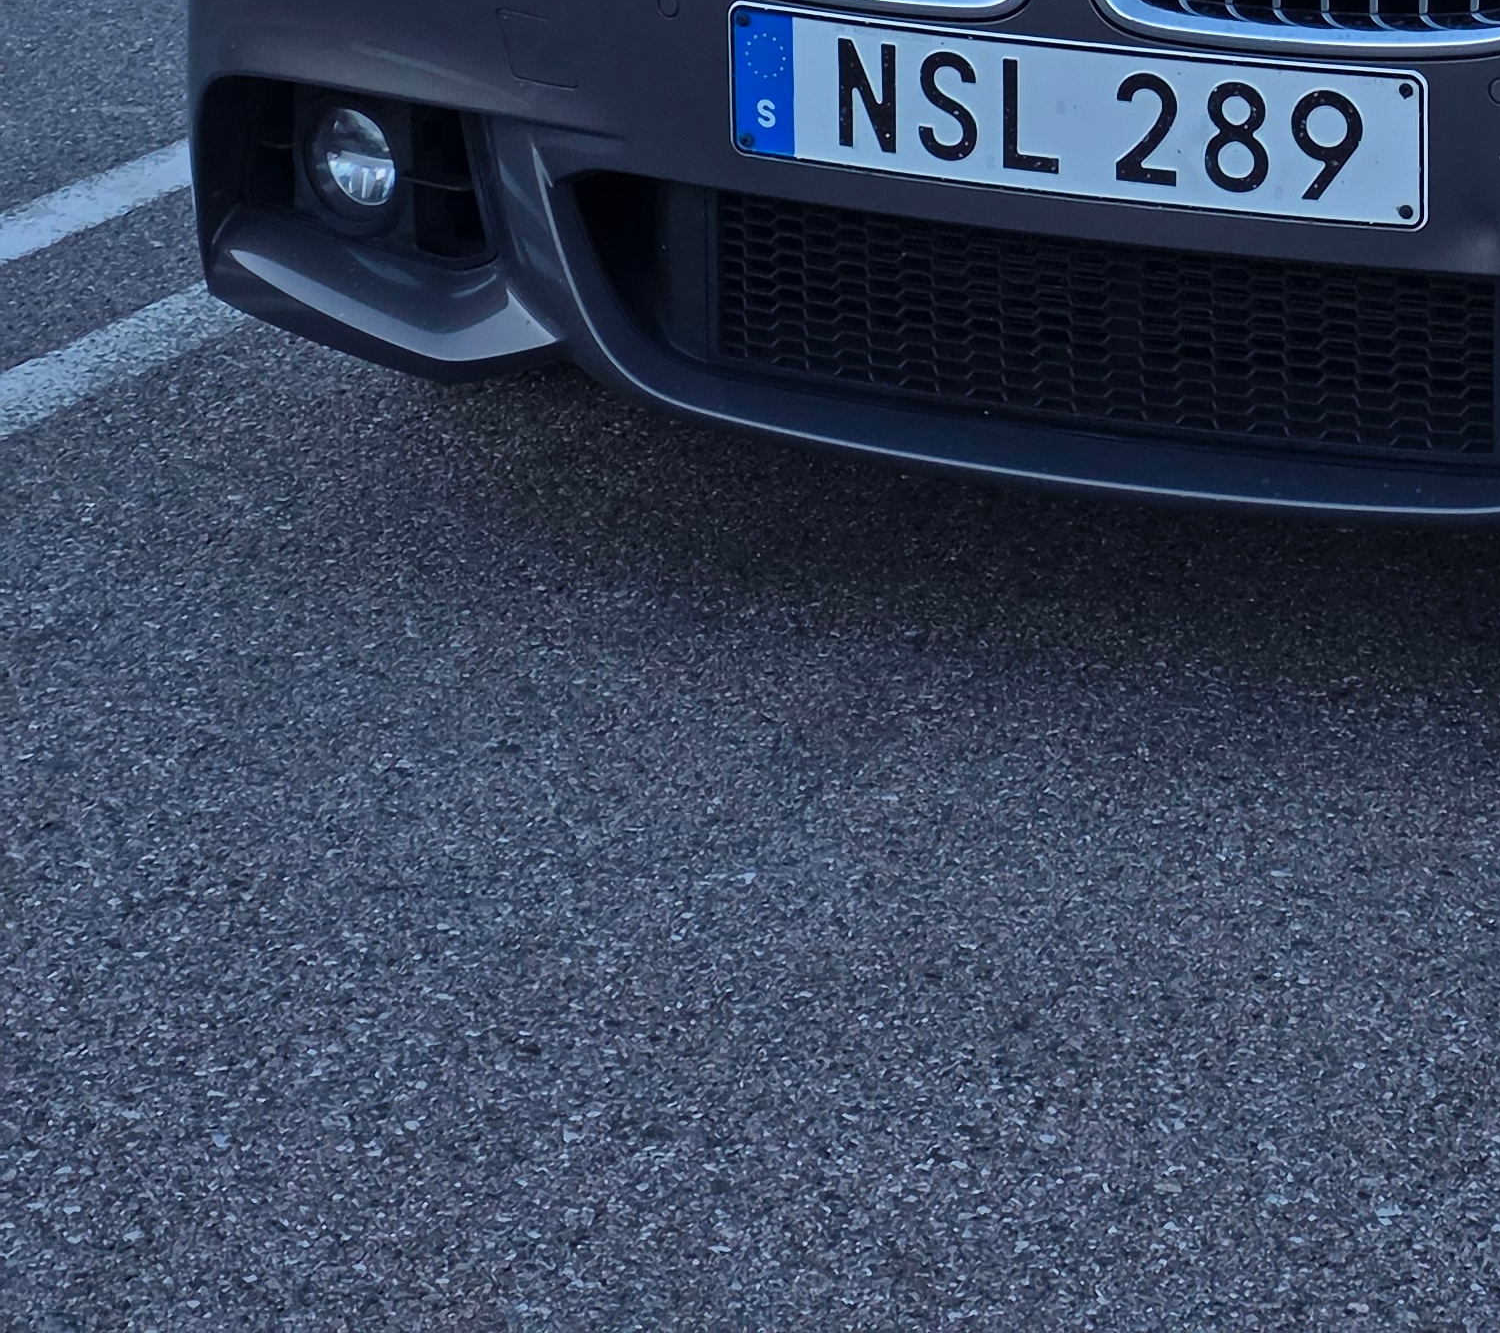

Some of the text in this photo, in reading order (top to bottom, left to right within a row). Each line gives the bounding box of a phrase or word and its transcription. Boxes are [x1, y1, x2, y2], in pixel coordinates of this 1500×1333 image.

[755, 37, 1364, 202] S NSL 289
